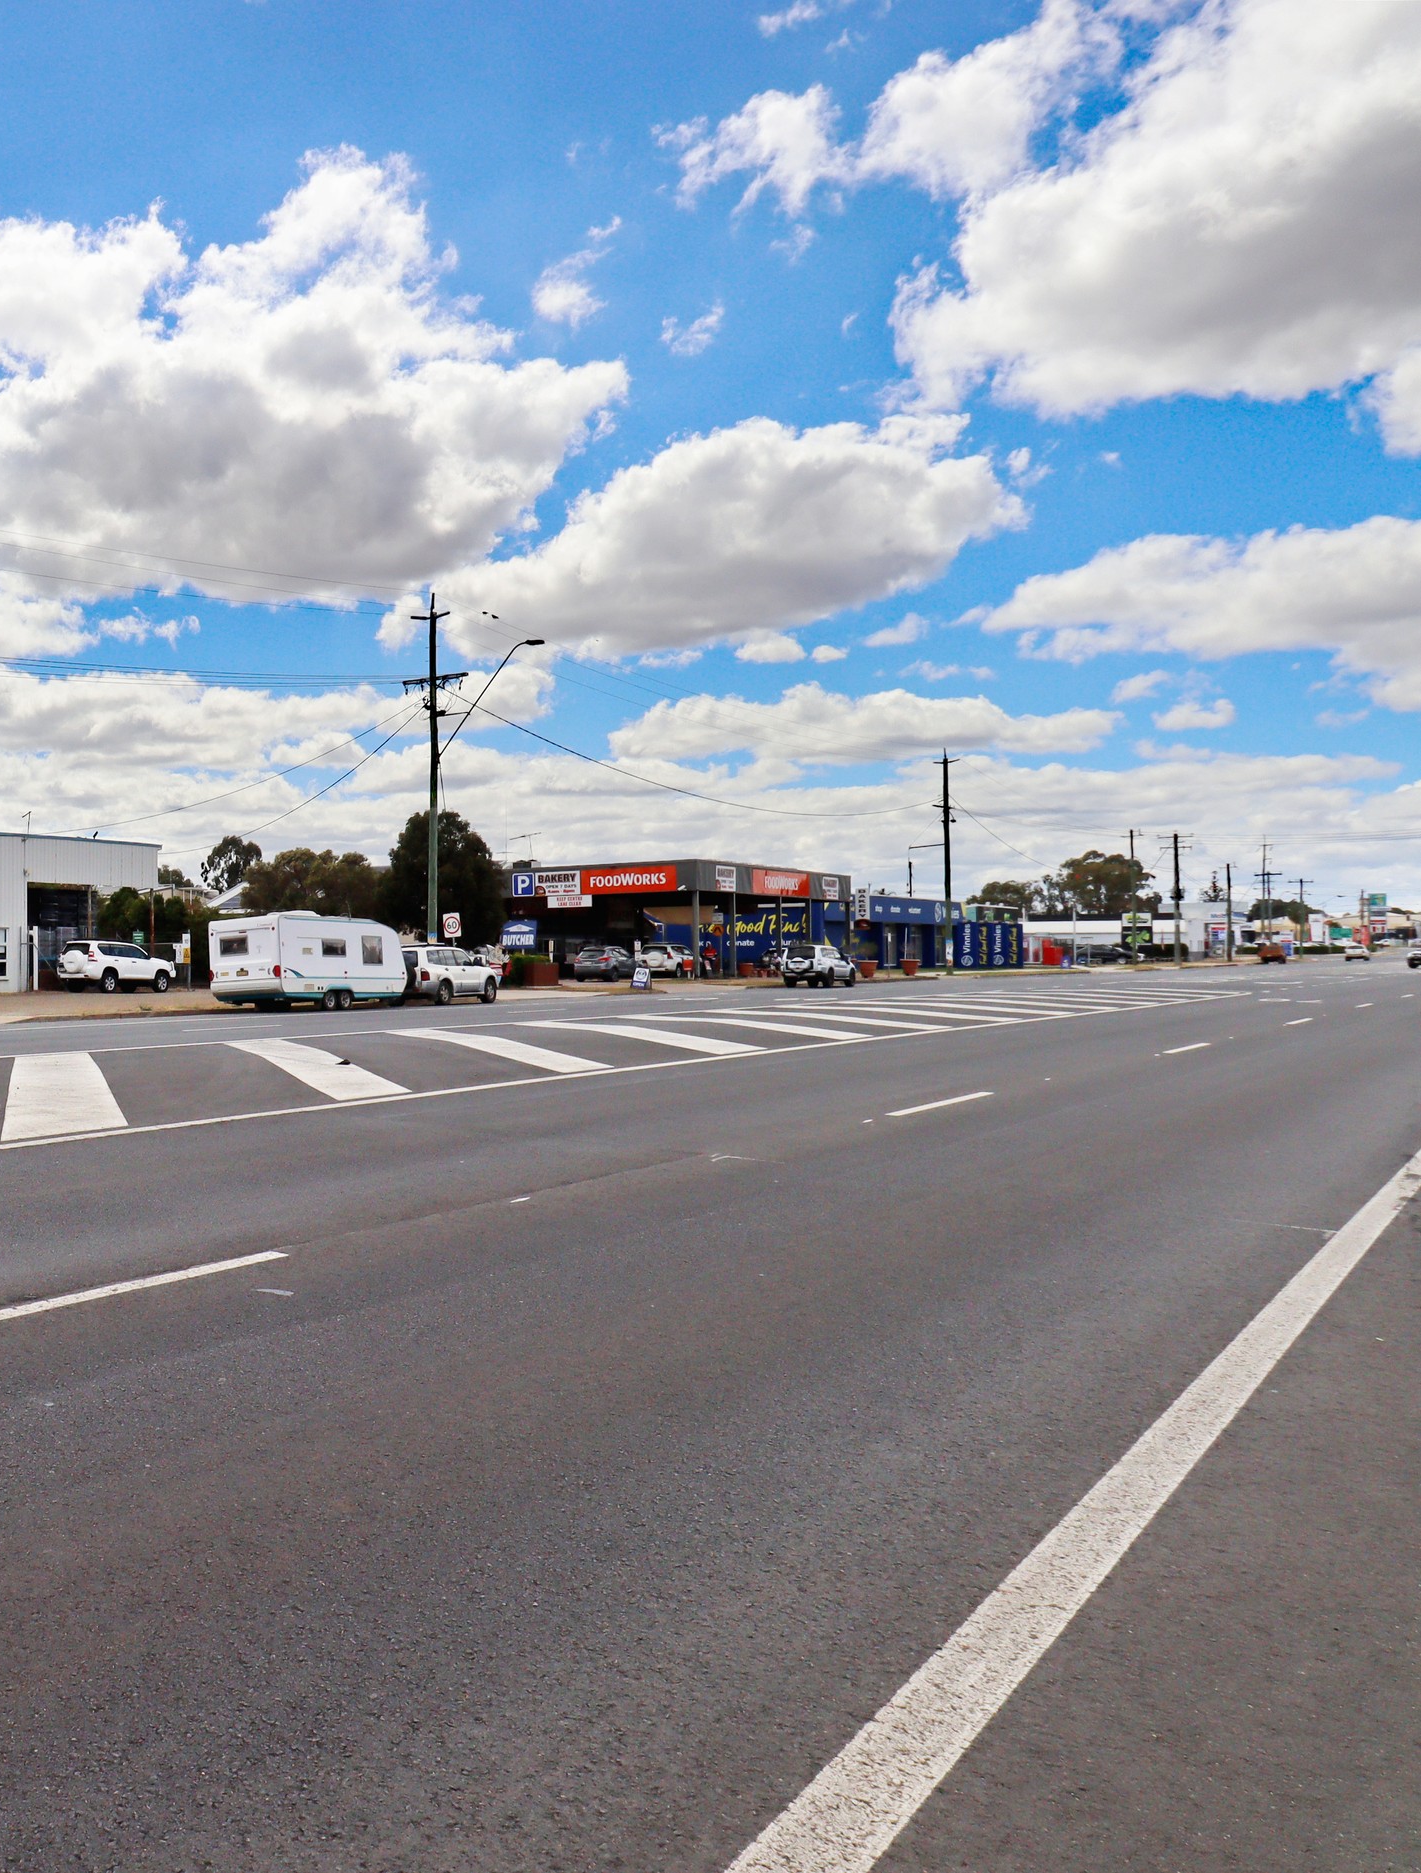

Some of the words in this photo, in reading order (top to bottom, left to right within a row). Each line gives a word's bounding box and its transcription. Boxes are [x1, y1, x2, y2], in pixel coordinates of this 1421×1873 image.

[517, 875, 530, 894] P
[538, 873, 577, 884] BAKERY
[590, 872, 666, 888] FOODWORKS
[764, 875, 798, 891] FOODWORKS
[858, 889, 867, 918] BAKERY
[446, 920, 457, 929] 60
[502, 934, 535, 946] BUTCHER
[962, 923, 971, 953] Vinnies
[993, 924, 1002, 953] Vinnies
